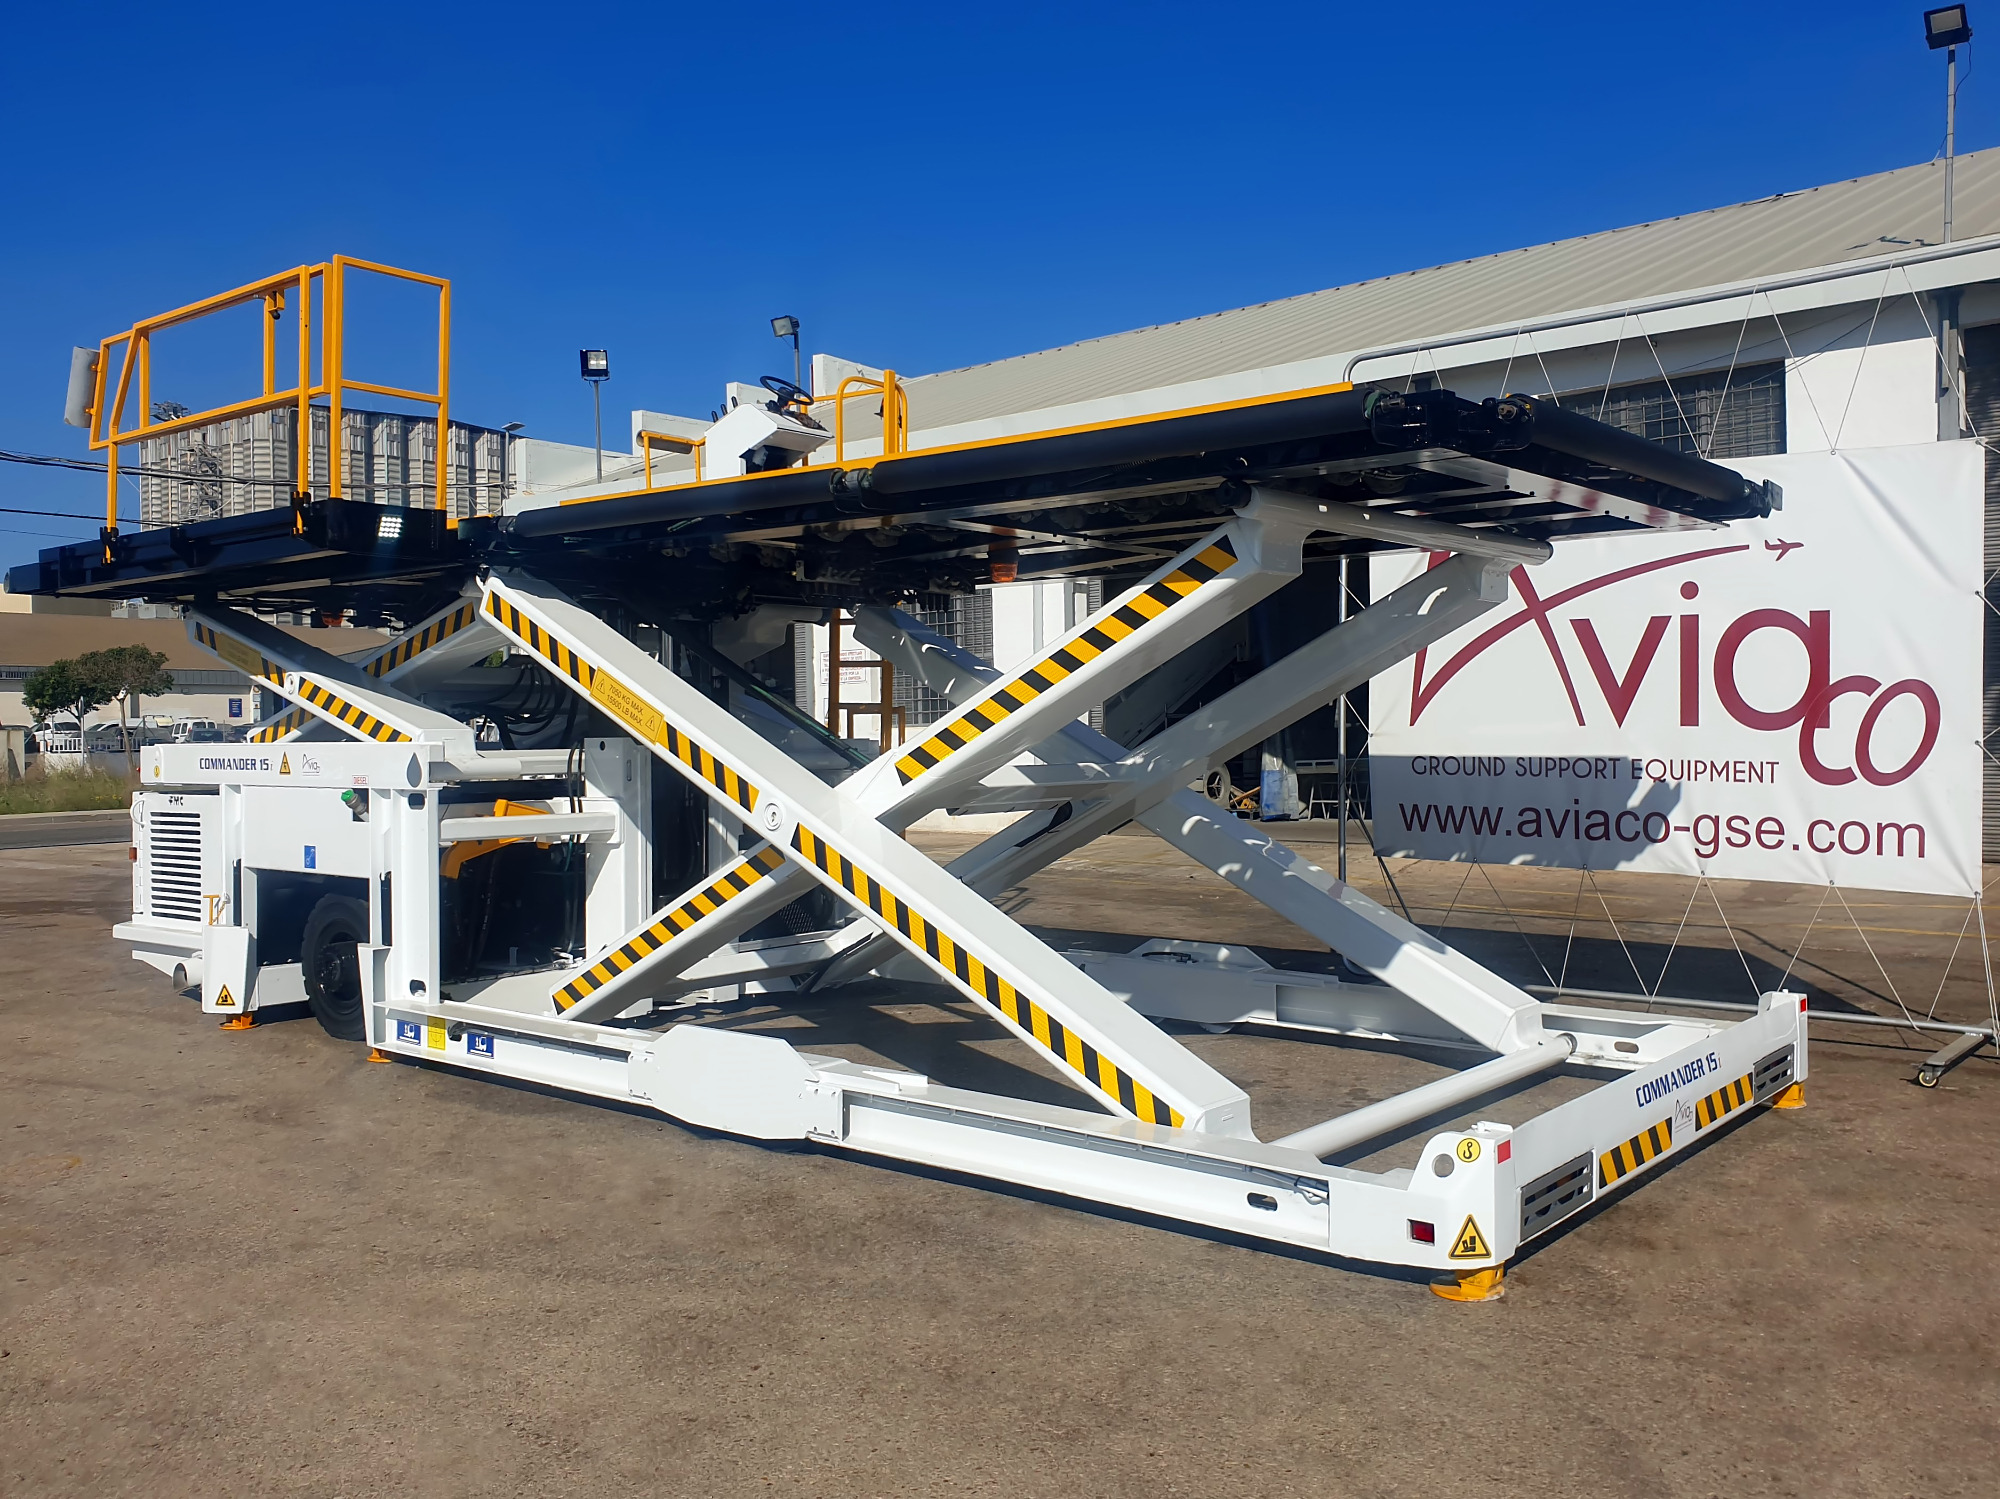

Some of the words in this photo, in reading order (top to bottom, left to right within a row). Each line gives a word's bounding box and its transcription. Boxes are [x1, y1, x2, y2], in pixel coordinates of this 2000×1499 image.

[607, 694, 621, 710] 15500
[622, 705, 629, 716] LB
[609, 684, 621, 699] 7050
[622, 694, 631, 705] KG
[199, 757, 257, 772] COMMANDER
[1411, 755, 1506, 777] GROUND
[1515, 756, 1621, 780] SUPPORT
[1630, 758, 1780, 784] EQUIPMENT
[1399, 798, 1926, 859] www.aviaco-gse.com
[1635, 1058, 1706, 1108] COMMANDER
